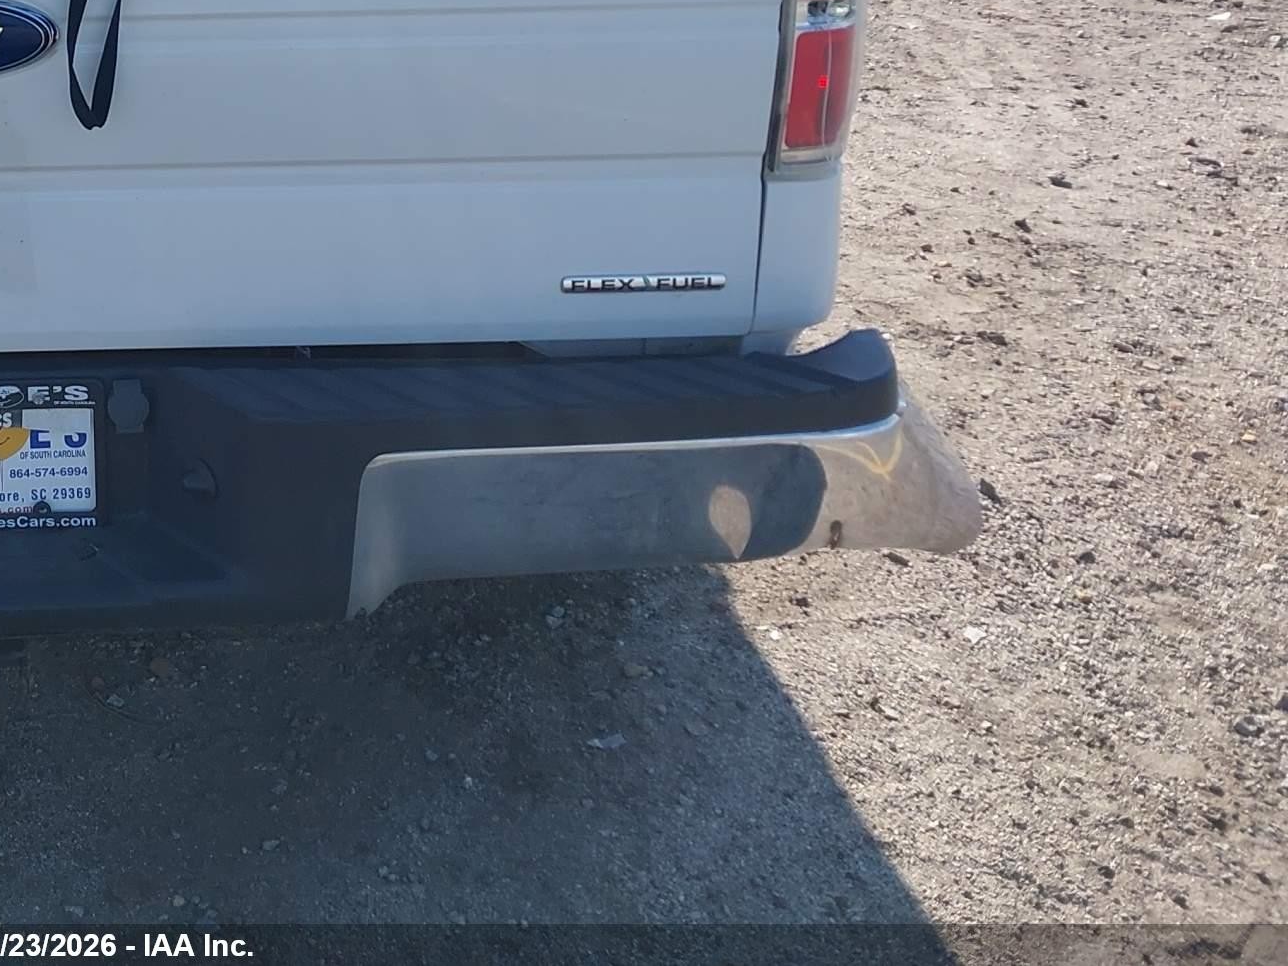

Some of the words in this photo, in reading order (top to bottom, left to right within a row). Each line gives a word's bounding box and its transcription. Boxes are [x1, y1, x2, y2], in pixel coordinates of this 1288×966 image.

[570, 278, 636, 292] FLEX
[655, 276, 724, 290] FUEL
[19, 450, 30, 459] OF
[31, 449, 52, 460] SOUTH
[53, 447, 87, 458] CAROLINA
[9, 466, 89, 479] 864-574-6994
[31, 488, 47, 501] SC
[52, 487, 92, 500] 29369
